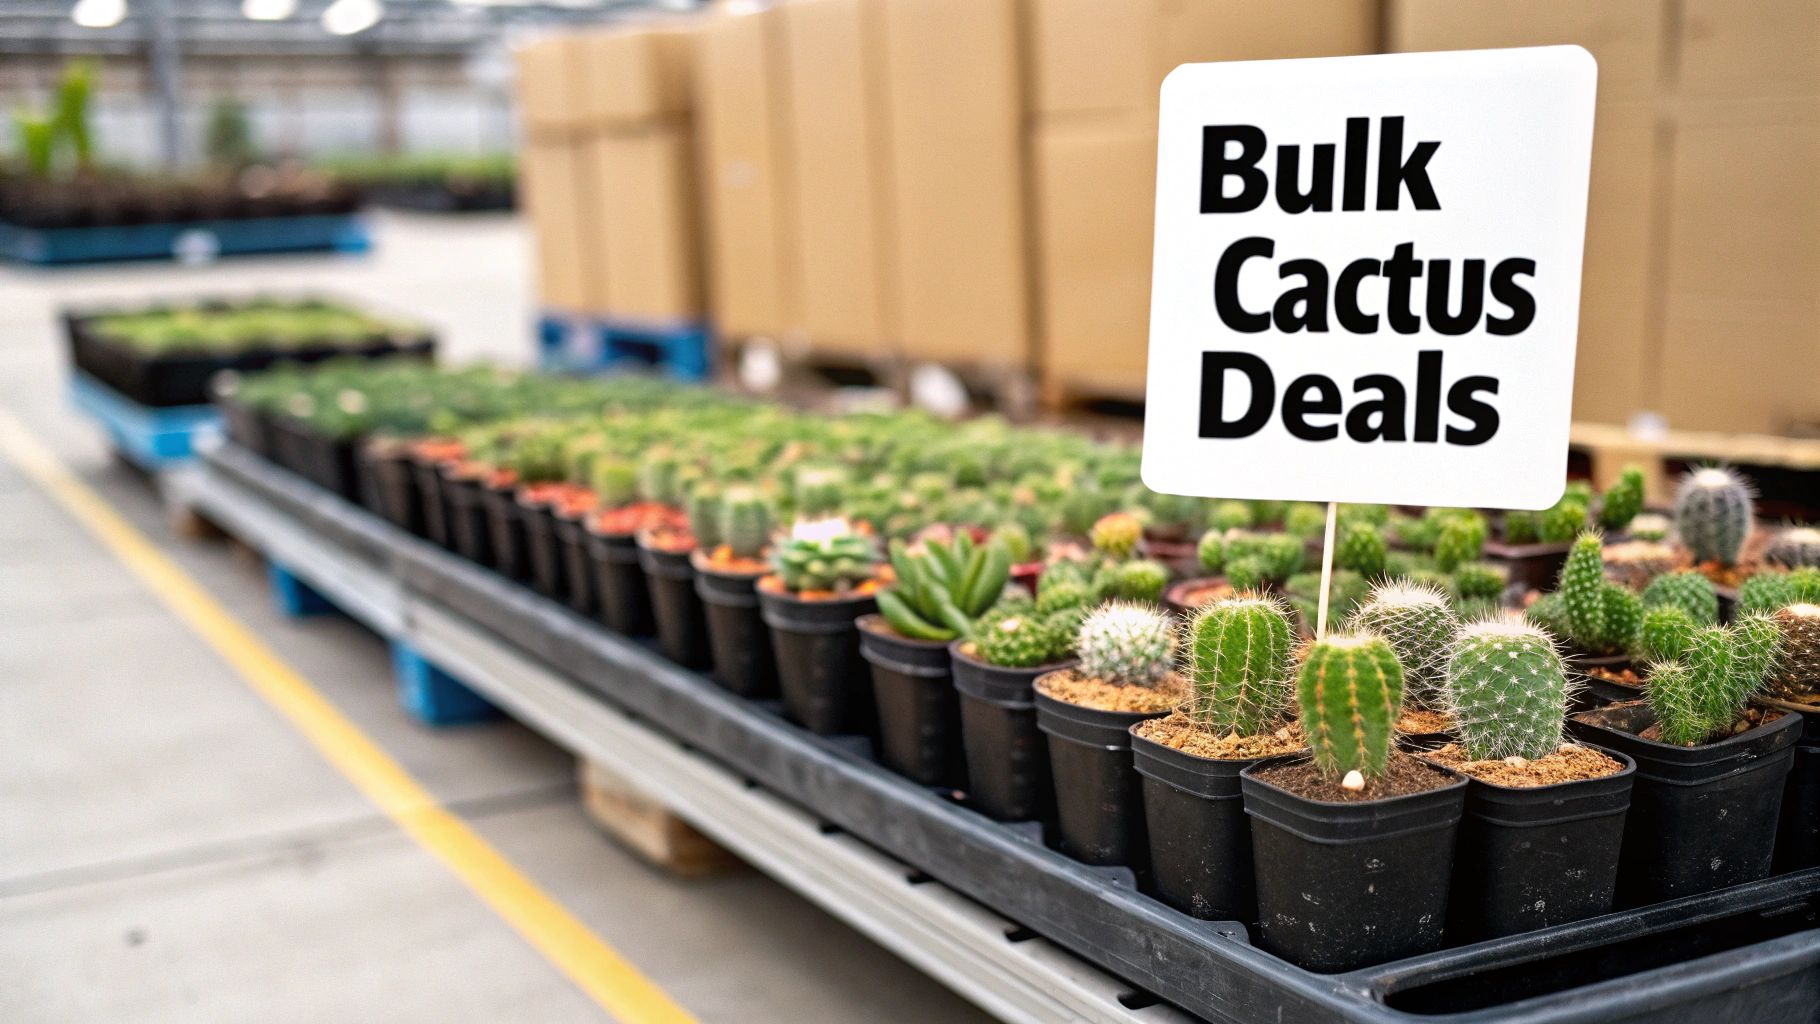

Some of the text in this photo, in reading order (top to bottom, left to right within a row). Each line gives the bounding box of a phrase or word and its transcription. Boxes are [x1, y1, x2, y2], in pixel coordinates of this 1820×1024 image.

[1199, 115, 1442, 215] Bulk
[1214, 236, 1537, 337] Cactus
[1198, 349, 1500, 447] Deals
